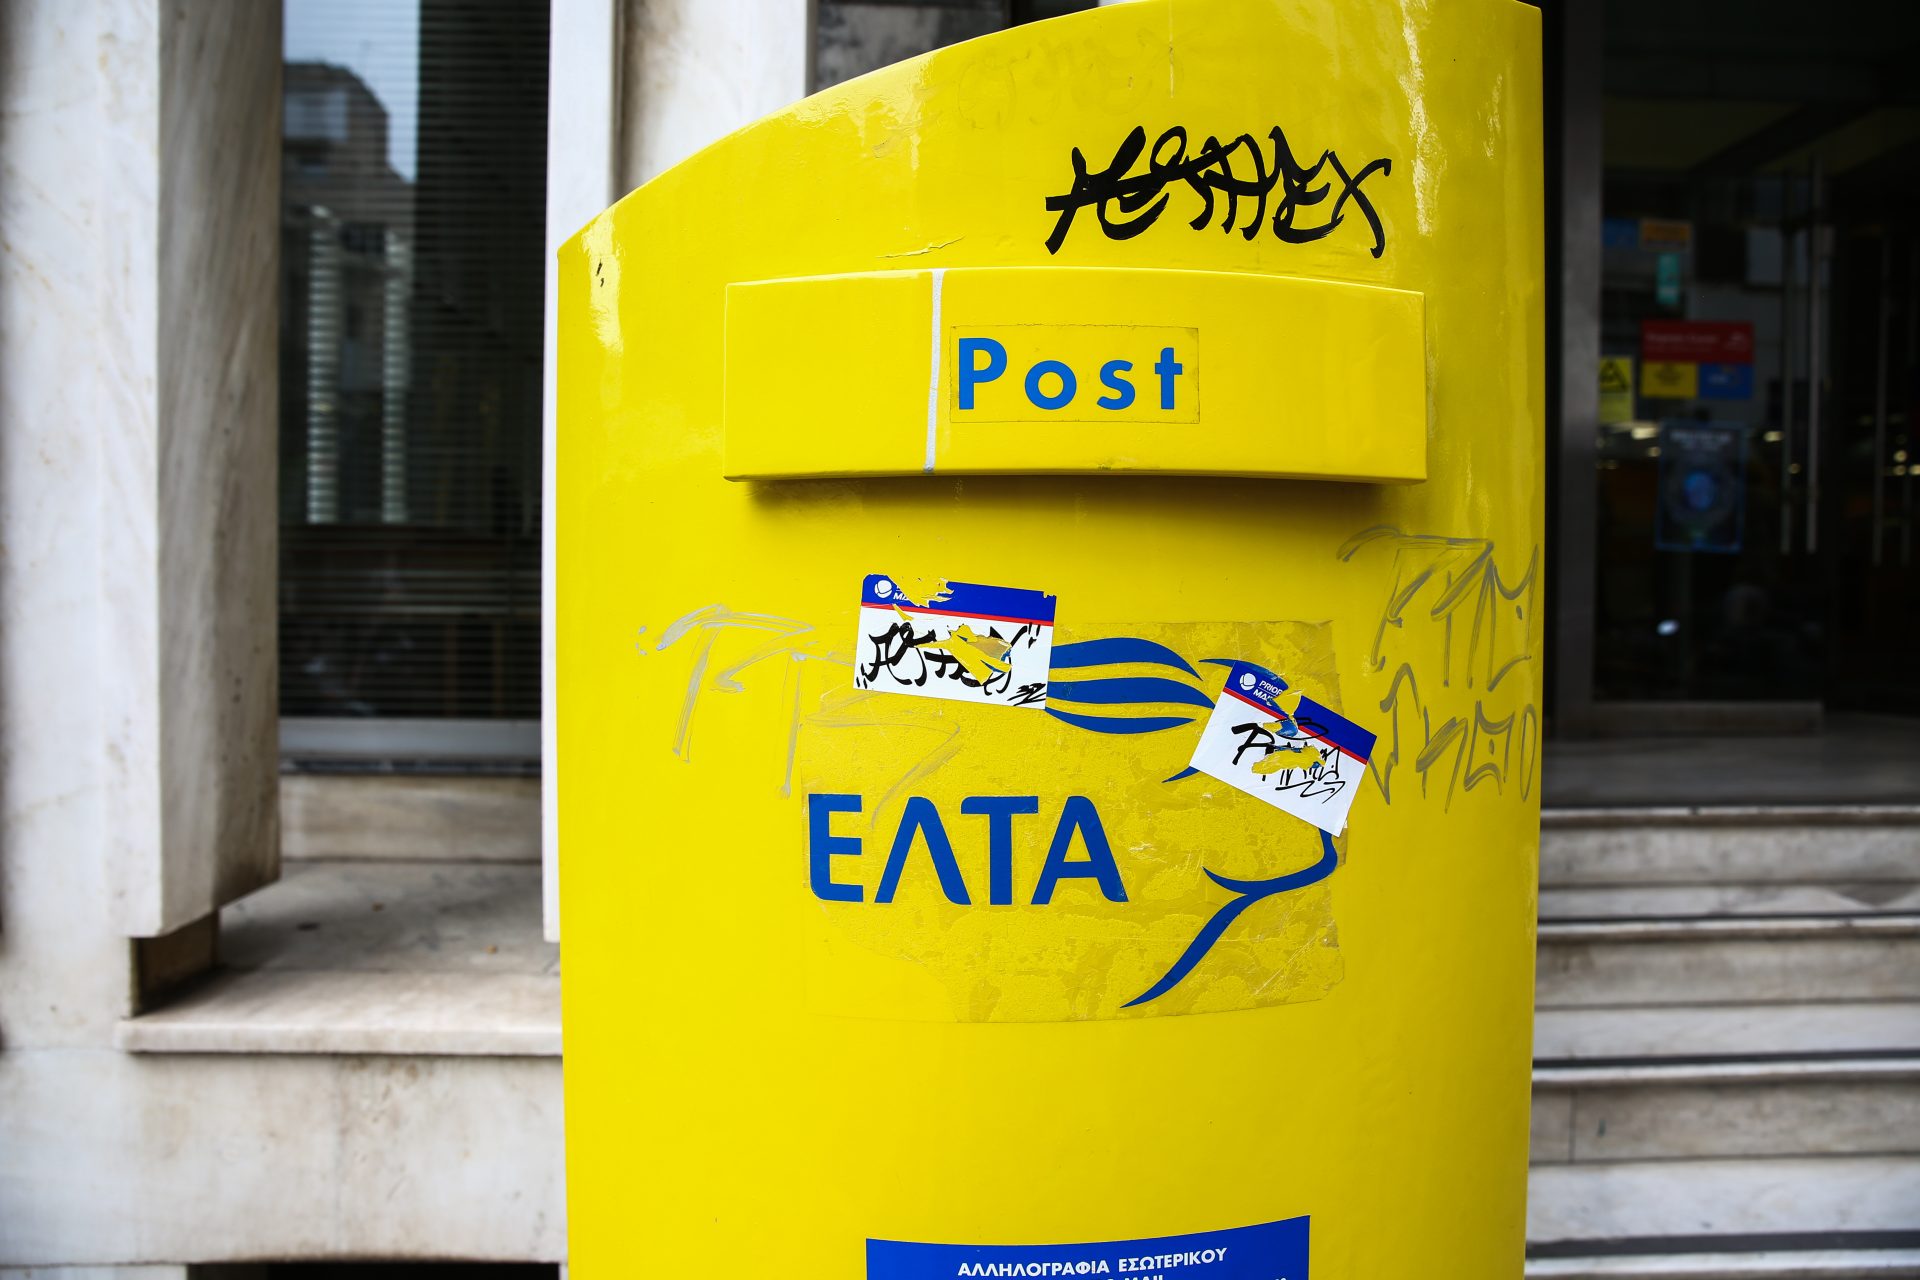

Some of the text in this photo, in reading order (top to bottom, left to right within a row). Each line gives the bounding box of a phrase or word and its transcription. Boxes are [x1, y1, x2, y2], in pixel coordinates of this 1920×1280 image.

[959, 338, 1183, 410] Post
[808, 793, 1129, 906] ΕΛΤΑ
[958, 1248, 1227, 1277] ΑΛΛΗΛΟΓΡΑΦΙΑ ΕΣΩΤΕΡΙΚΟΥ
